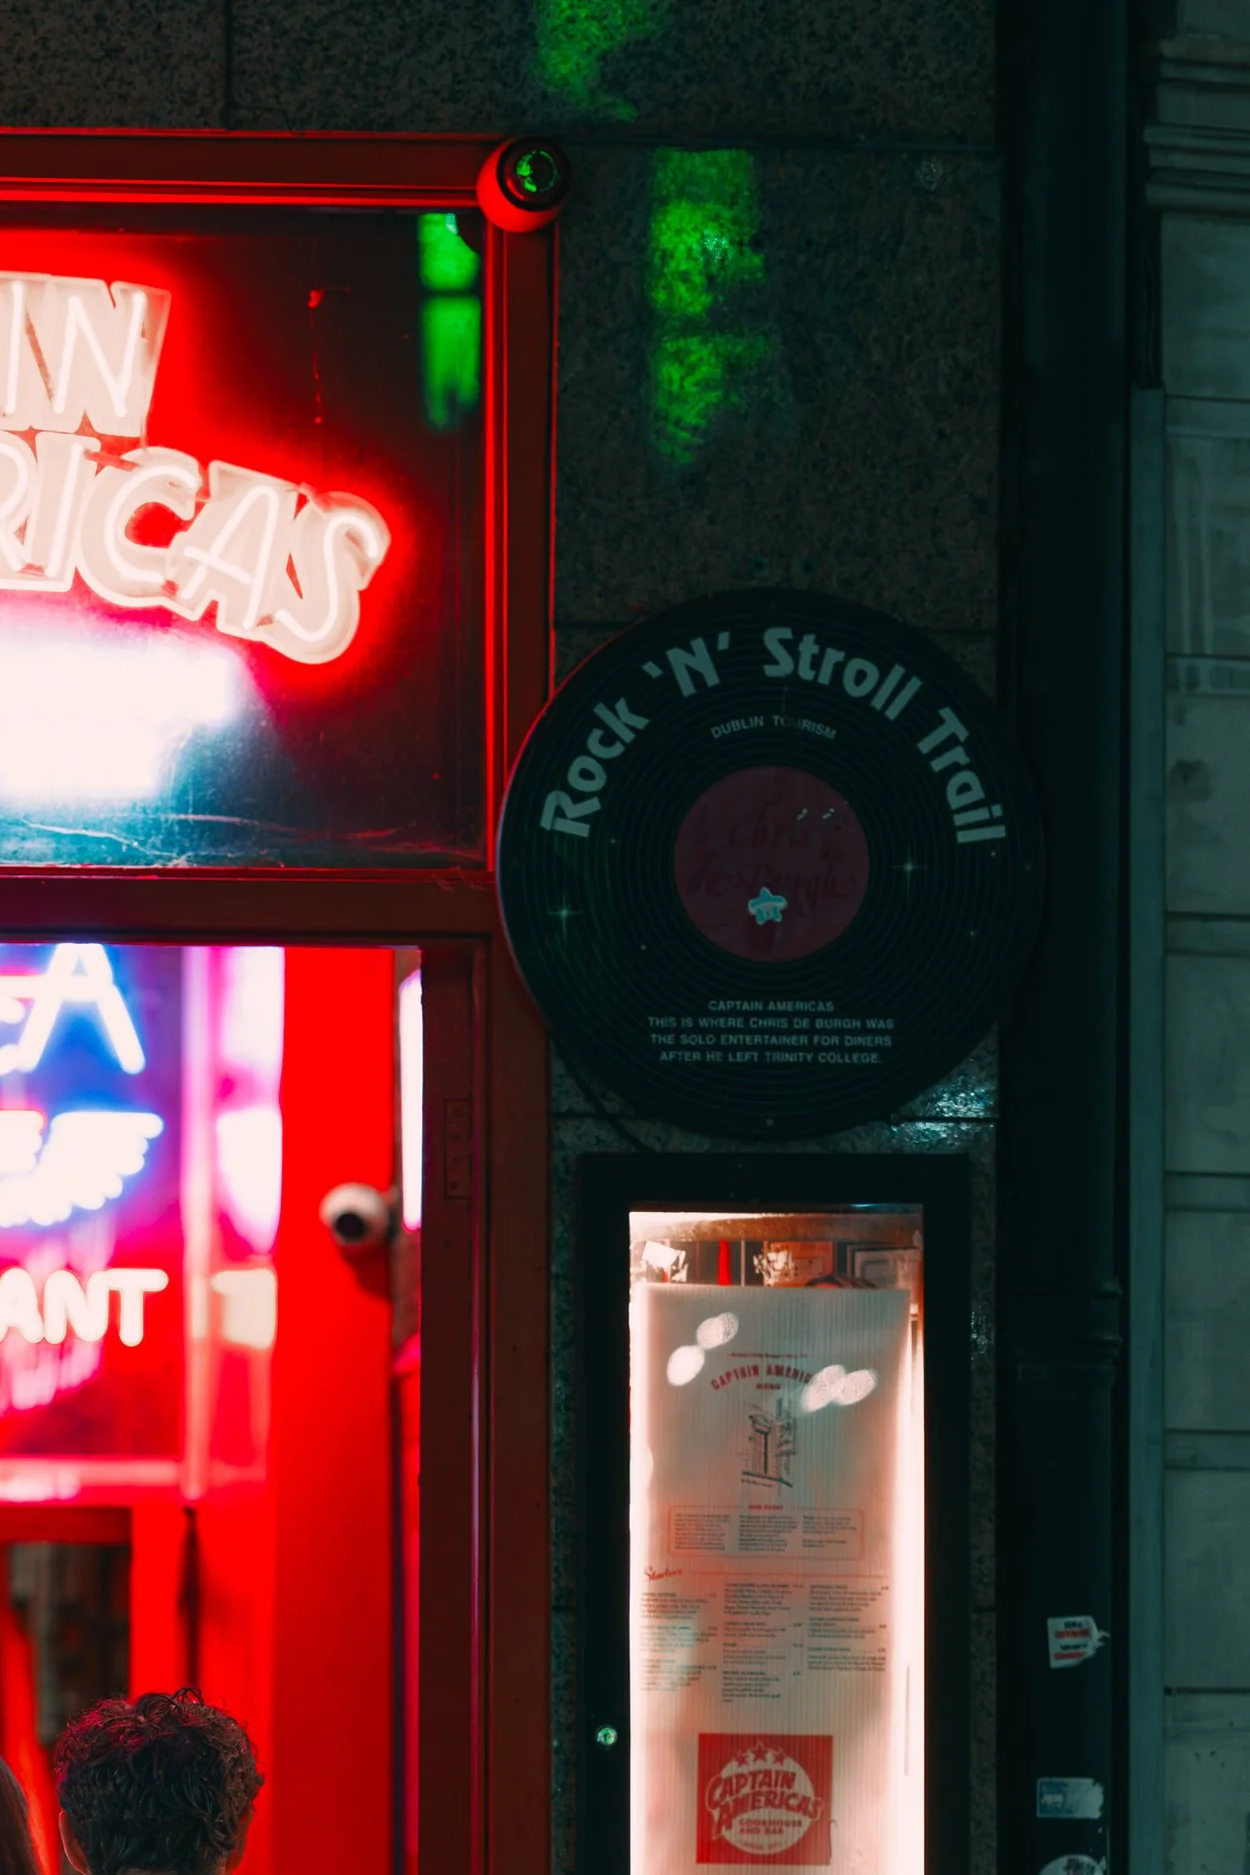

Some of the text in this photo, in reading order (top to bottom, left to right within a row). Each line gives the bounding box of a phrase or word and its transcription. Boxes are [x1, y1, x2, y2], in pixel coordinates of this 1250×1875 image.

[540, 696, 650, 838] Rock
[762, 626, 923, 721] Stroll
[916, 706, 1007, 844] Trail
[710, 714, 764, 740] DUBLIN
[707, 1000, 835, 1012] CAPTAIN AMERICAS
[648, 1016, 895, 1030] THIS IS WHERE CHRIS DE BURGH WAS
[650, 1034, 892, 1047] THE SOLO ENTERTAINER FOR DINERS
[659, 1051, 702, 1062] AFTER
[706, 1051, 723, 1062] HE
[728, 1051, 759, 1063] LEFT
[764, 1051, 813, 1063] TRINITY
[710, 1364, 760, 1391] CAPTAIN
[705, 1768, 796, 1813] CAPTAIN
[712, 1789, 824, 1840] AMERICAS
